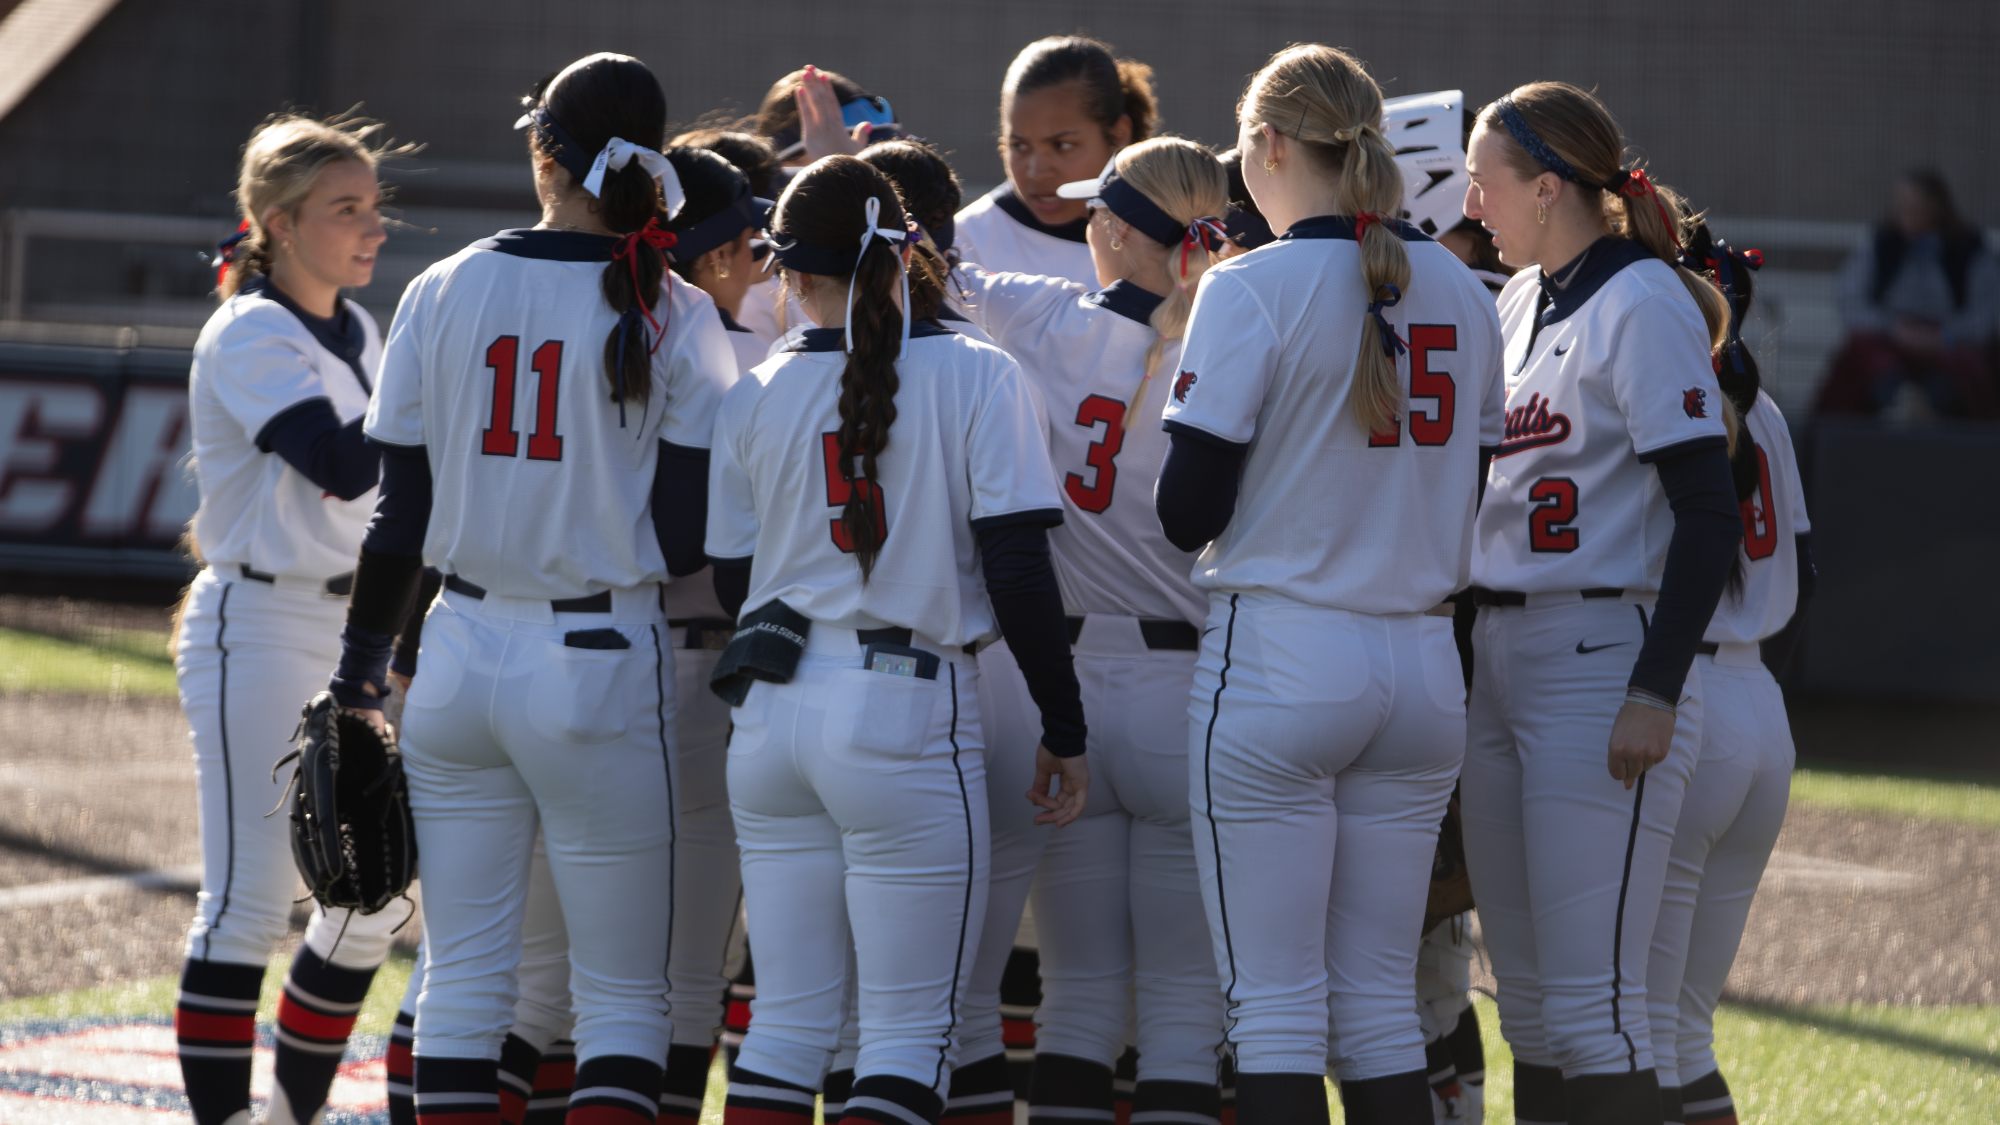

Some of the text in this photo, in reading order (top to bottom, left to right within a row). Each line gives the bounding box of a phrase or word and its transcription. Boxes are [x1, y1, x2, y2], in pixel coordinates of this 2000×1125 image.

[482, 335, 564, 462] 11
[1065, 392, 1127, 514] 3
[822, 431, 888, 554] 5
[1529, 476, 1580, 553] 2
